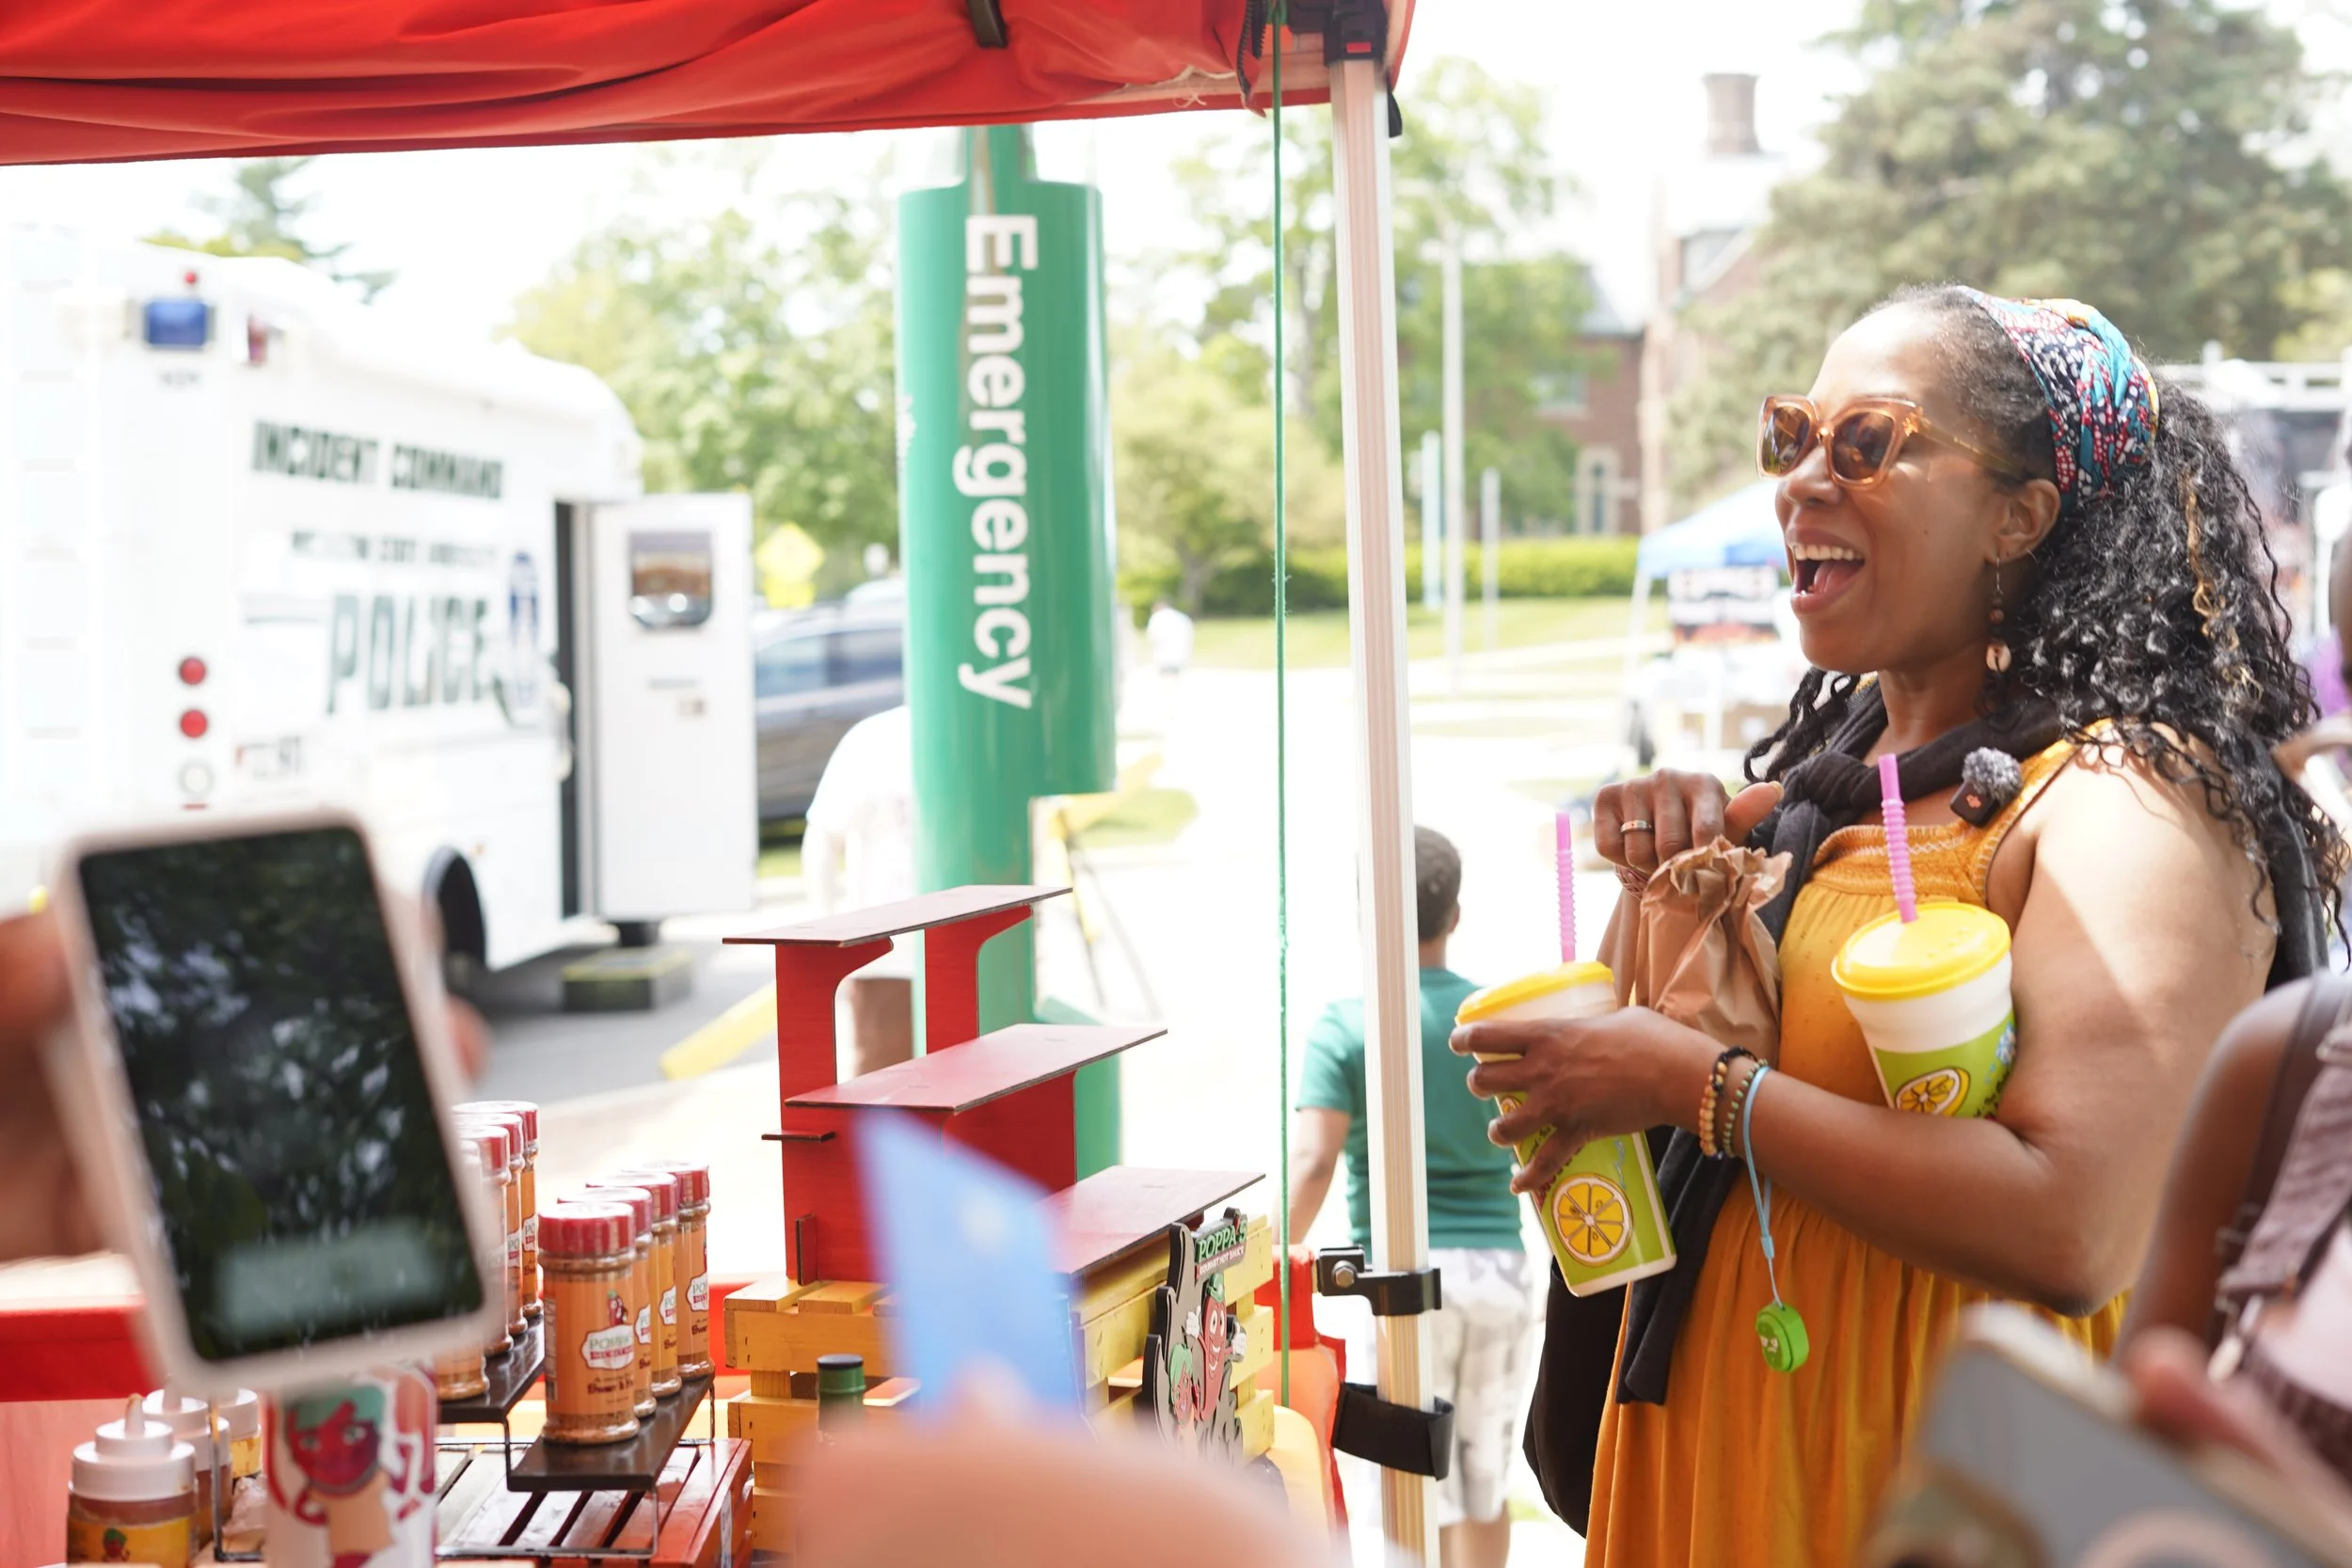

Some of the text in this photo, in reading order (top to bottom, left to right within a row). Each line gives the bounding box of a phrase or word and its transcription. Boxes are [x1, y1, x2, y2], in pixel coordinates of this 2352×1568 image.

[253, 420, 503, 499] INCIDENT COMMAND
[953, 214, 1038, 710] Emergency
[326, 594, 487, 715] POLICE
[1199, 1219, 1247, 1263] POPPA'S
